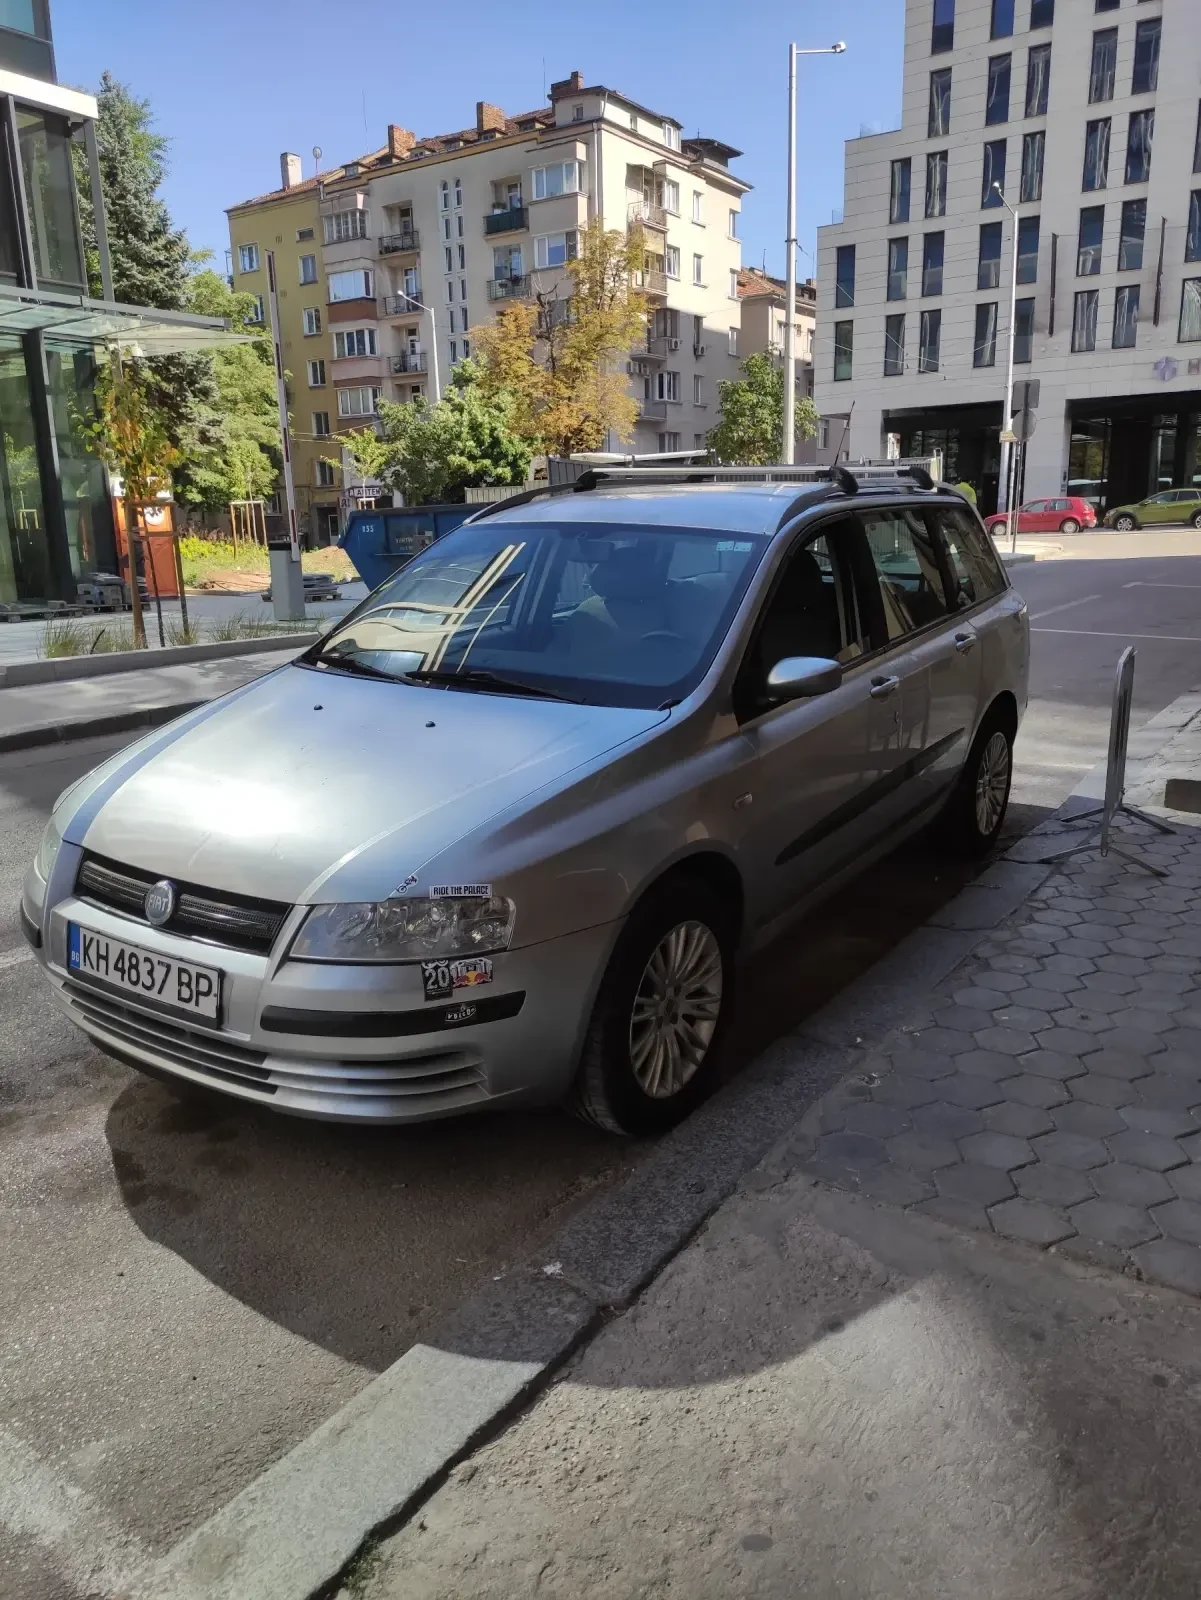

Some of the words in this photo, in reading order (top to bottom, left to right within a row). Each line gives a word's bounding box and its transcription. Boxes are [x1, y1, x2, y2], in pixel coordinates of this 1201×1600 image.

[433, 886, 449, 896] RIDE
[450, 886, 462, 895] THE
[463, 885, 489, 895] PALACE
[149, 894, 168, 912] FIAT
[71, 951, 80, 963] BG
[113, 948, 172, 995] 4837
[424, 966, 450, 990] 20
